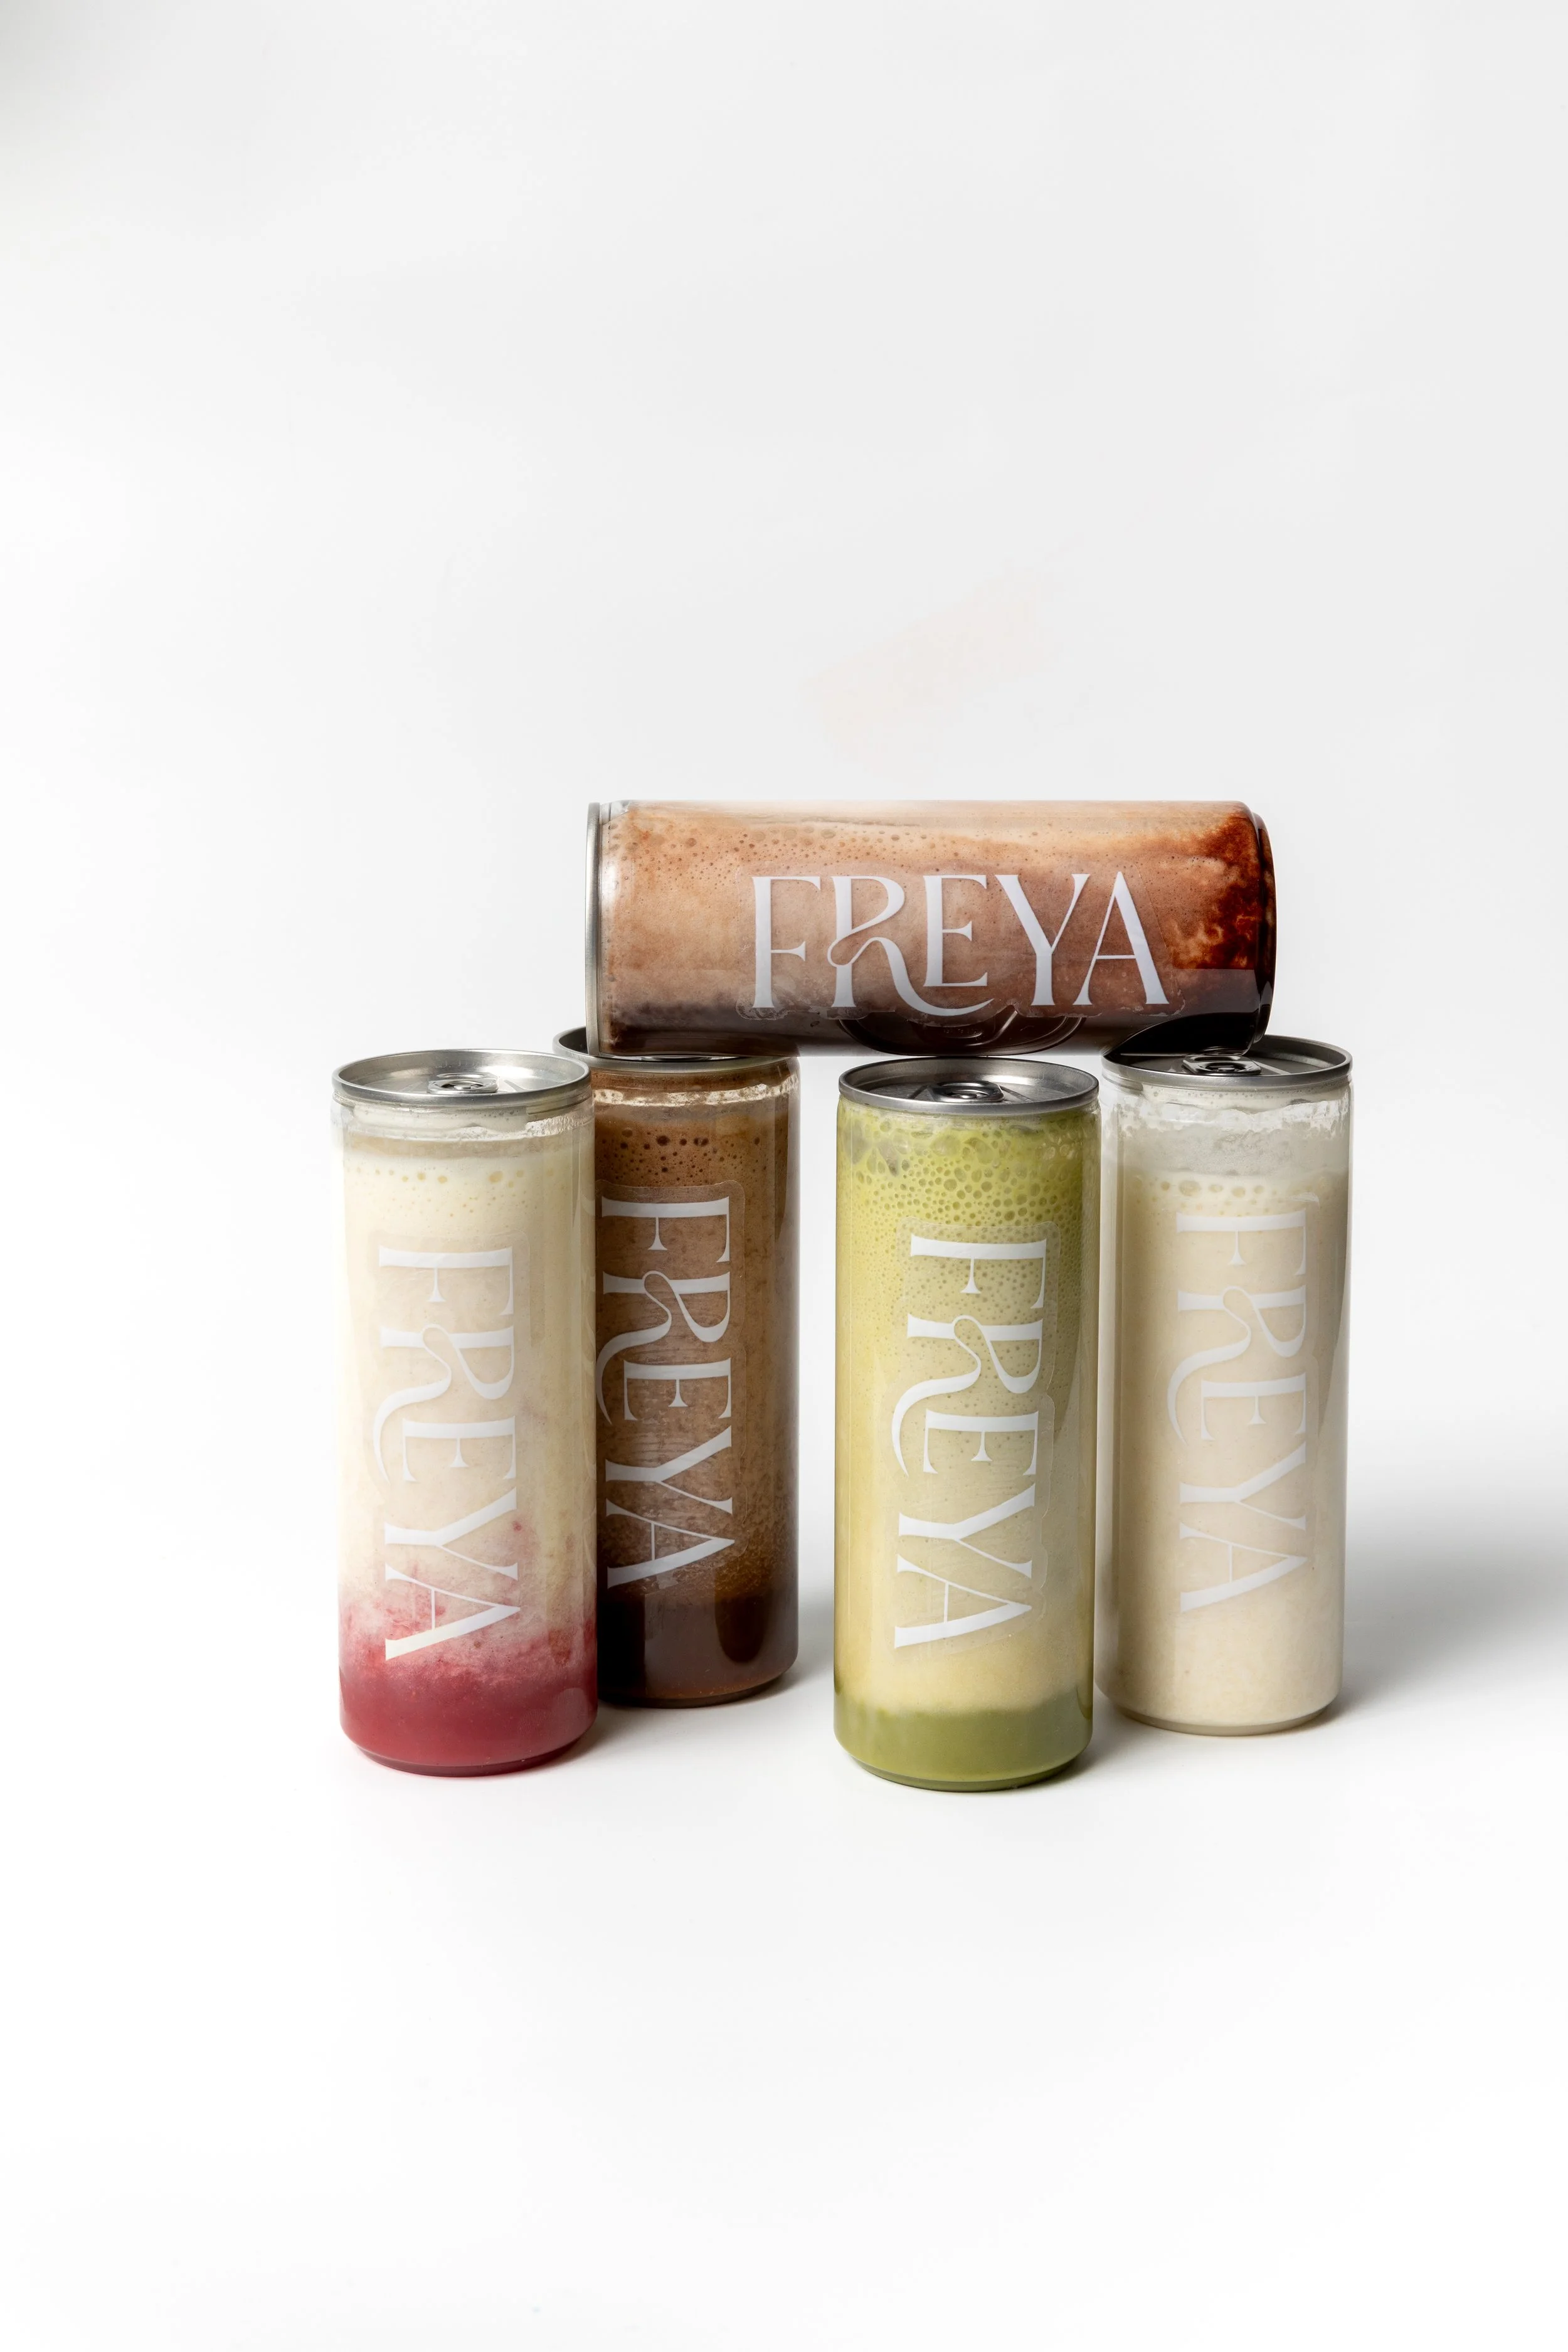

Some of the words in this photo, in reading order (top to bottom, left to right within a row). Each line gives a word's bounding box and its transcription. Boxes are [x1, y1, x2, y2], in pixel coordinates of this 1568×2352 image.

[753, 871, 1169, 1017] FREYA
[373, 1244, 520, 1661] FREYA
[596, 1196, 734, 1589] FREYA
[891, 1233, 1047, 1649] FREYA
[1167, 1210, 1308, 1614] FREYA
